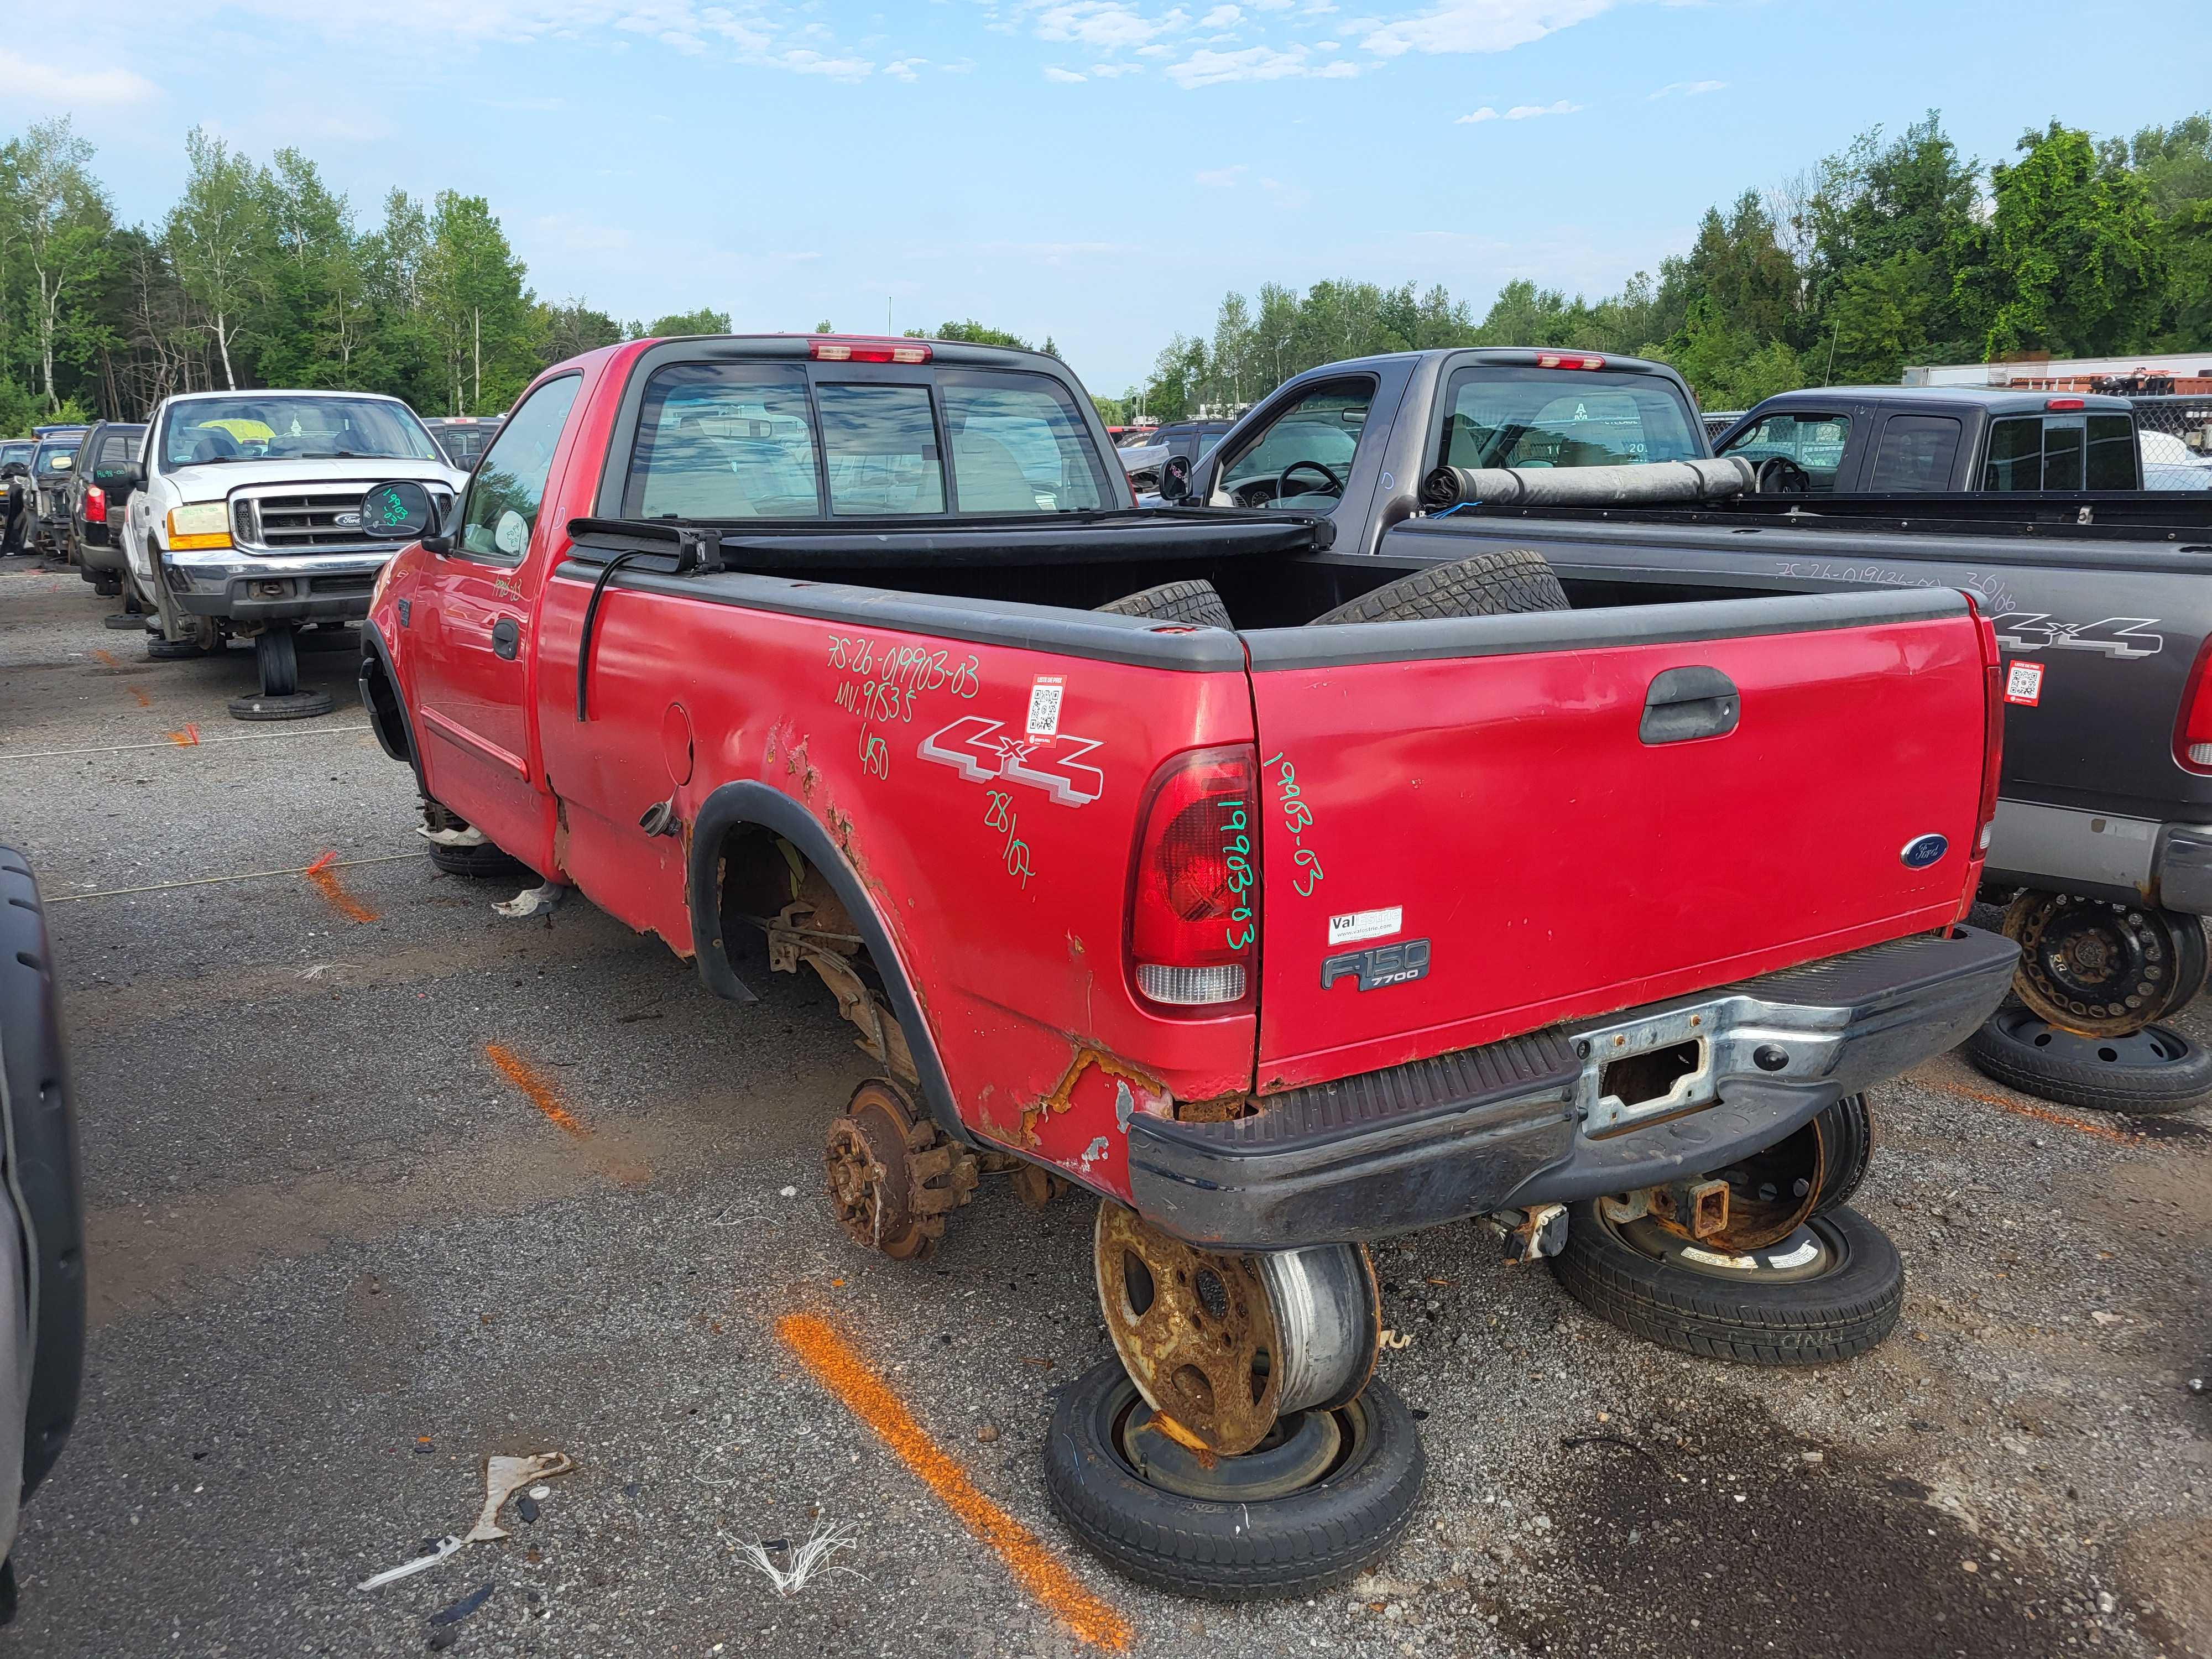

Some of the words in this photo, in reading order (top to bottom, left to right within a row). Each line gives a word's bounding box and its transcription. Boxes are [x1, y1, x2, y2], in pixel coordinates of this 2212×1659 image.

[1263, 752, 1324, 897] 19903-03
[1915, 842, 1939, 860] Ford
[1217, 800, 1255, 950] 19903-03
[1337, 924, 1392, 937] www.valestrie.com
[1324, 940, 1430, 988] F-150
[1371, 969, 1419, 986] 7700
